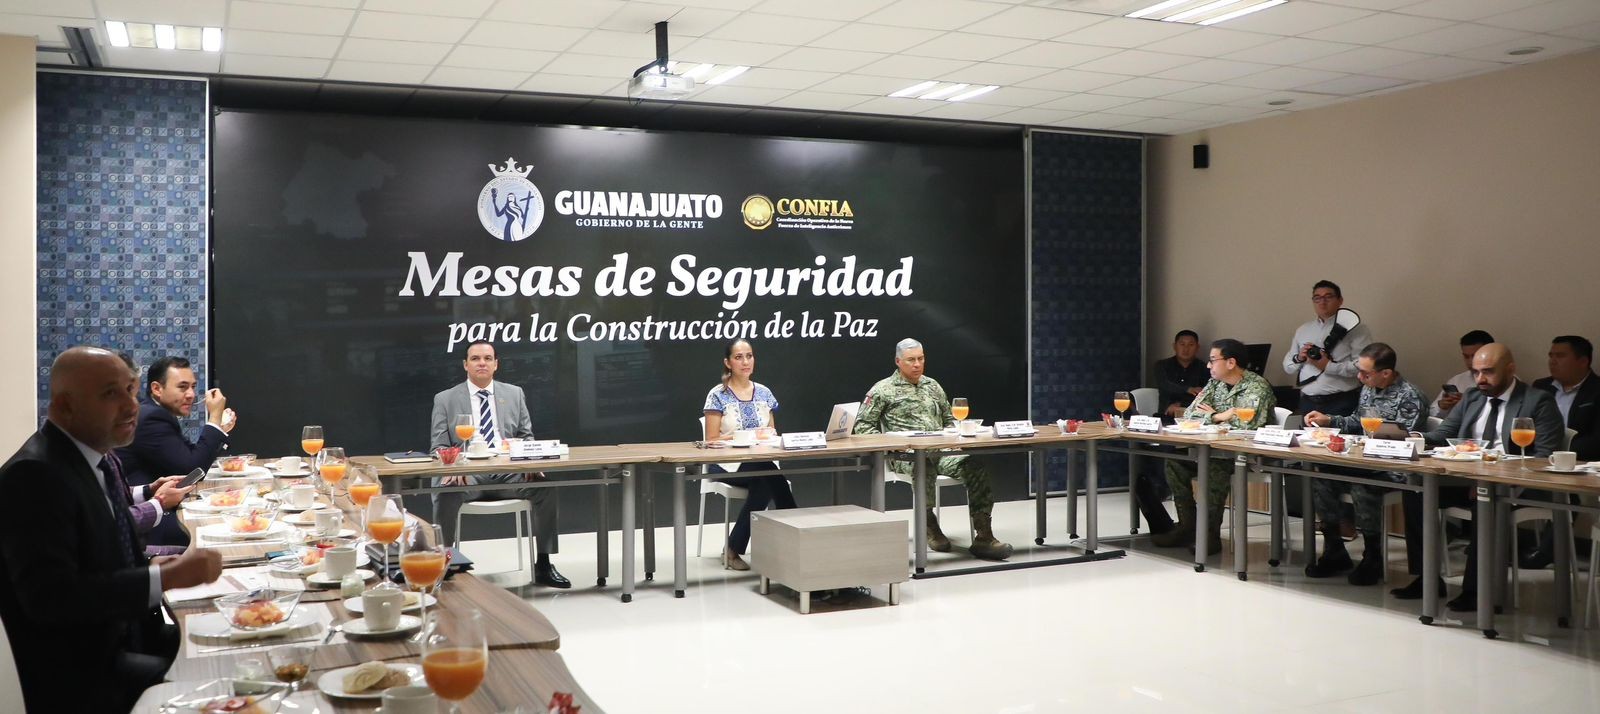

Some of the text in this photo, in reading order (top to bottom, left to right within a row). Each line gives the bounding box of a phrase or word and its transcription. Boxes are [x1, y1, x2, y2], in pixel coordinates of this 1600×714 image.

[555, 190, 723, 219] GUANAJUATO
[776, 198, 853, 216] CONFIA
[575, 218, 704, 229] GOBIERNO DE LA GENTE
[399, 251, 914, 309] Mesas de Seguridad
[447, 309, 879, 353] para la Construcción de la Paz
